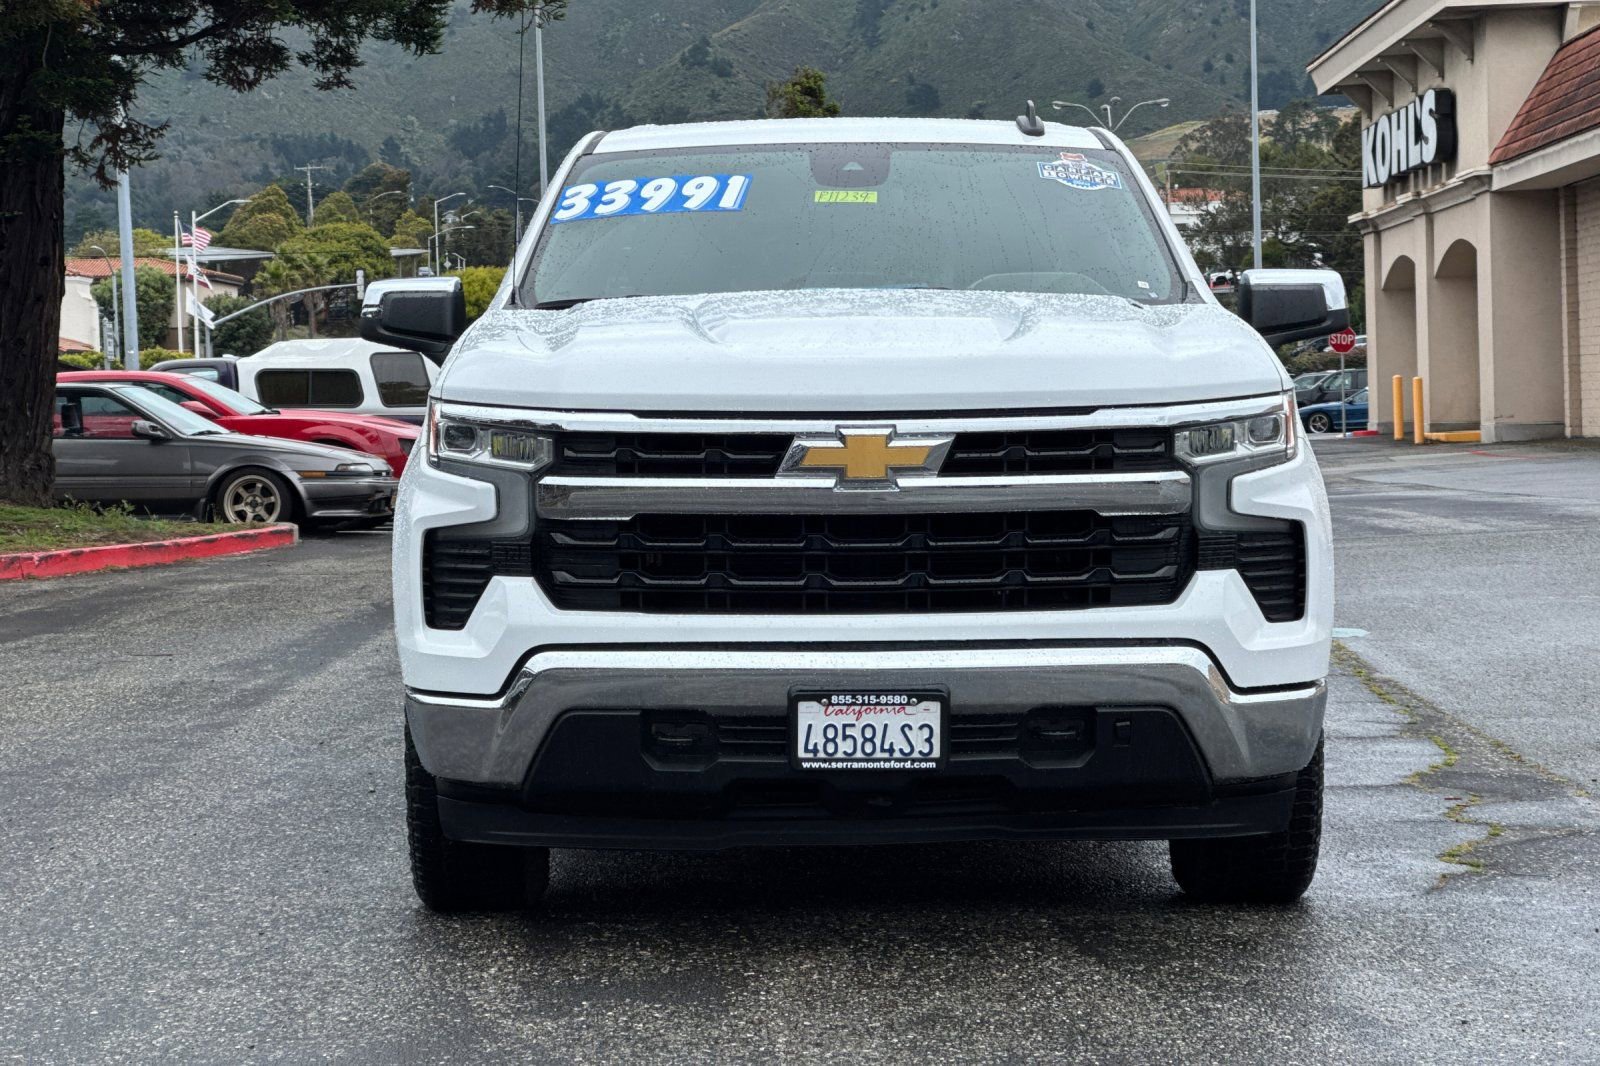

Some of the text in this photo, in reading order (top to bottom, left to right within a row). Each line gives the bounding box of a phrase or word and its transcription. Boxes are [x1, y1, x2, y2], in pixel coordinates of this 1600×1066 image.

[1362, 89, 1437, 189] KOHL'S
[1043, 164, 1116, 181] CARFAX
[1057, 172, 1115, 186] OWNER
[554, 175, 749, 220] 33991
[1330, 333, 1354, 345] STOP
[831, 695, 908, 704] 855-315-9580
[824, 704, 916, 721] California
[803, 723, 934, 757] 48584S3
[802, 760, 936, 769] www.serramonteford.com
